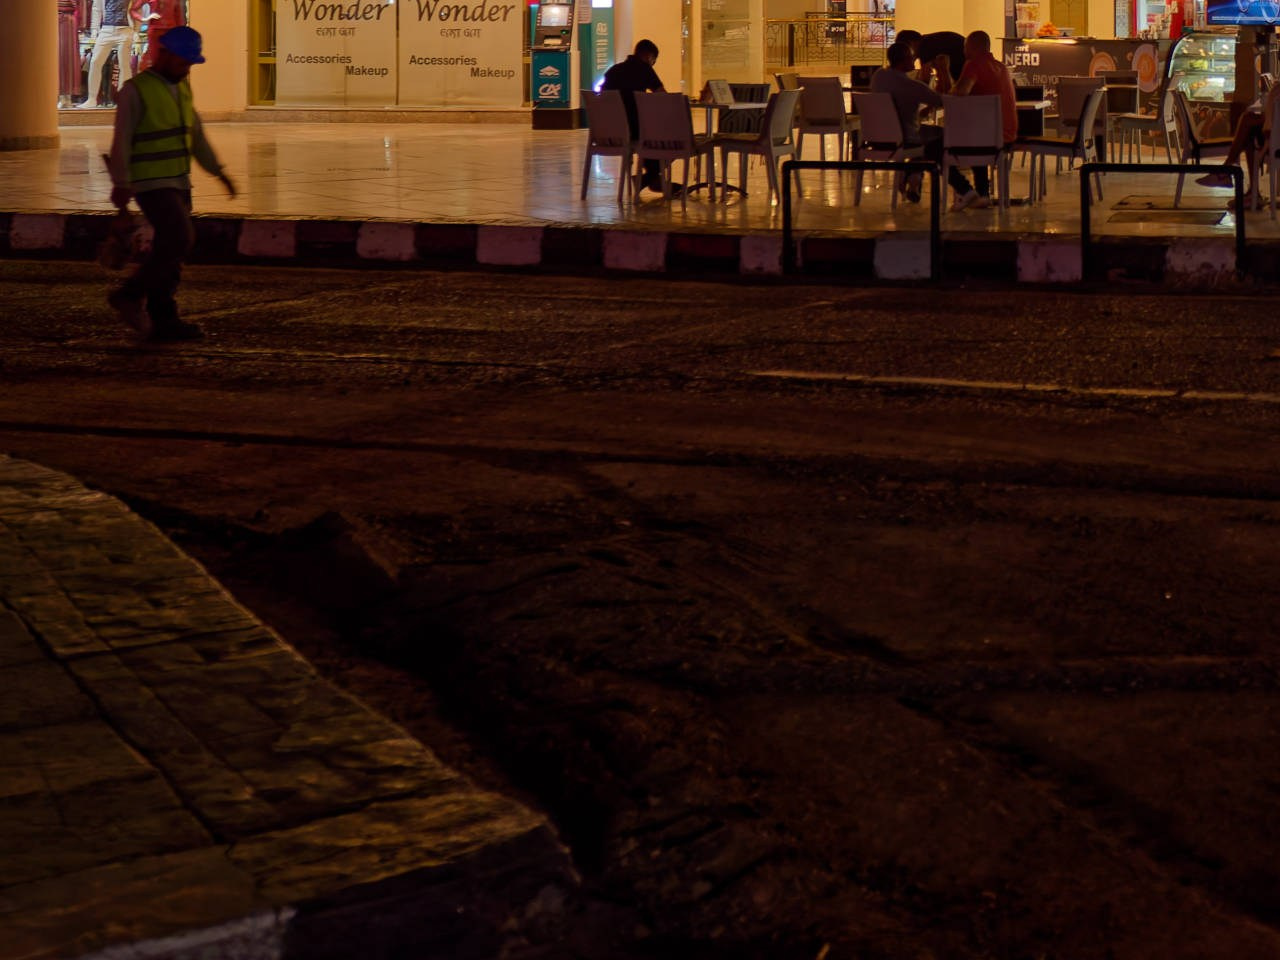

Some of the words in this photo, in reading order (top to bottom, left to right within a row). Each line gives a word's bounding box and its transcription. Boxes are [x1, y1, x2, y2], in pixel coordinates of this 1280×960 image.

[286, 53, 353, 65] Accessories
[409, 55, 478, 66] Accessories
[1004, 52, 1041, 67] NERO
[345, 65, 389, 78] Makeup
[470, 67, 516, 80] Makeup
